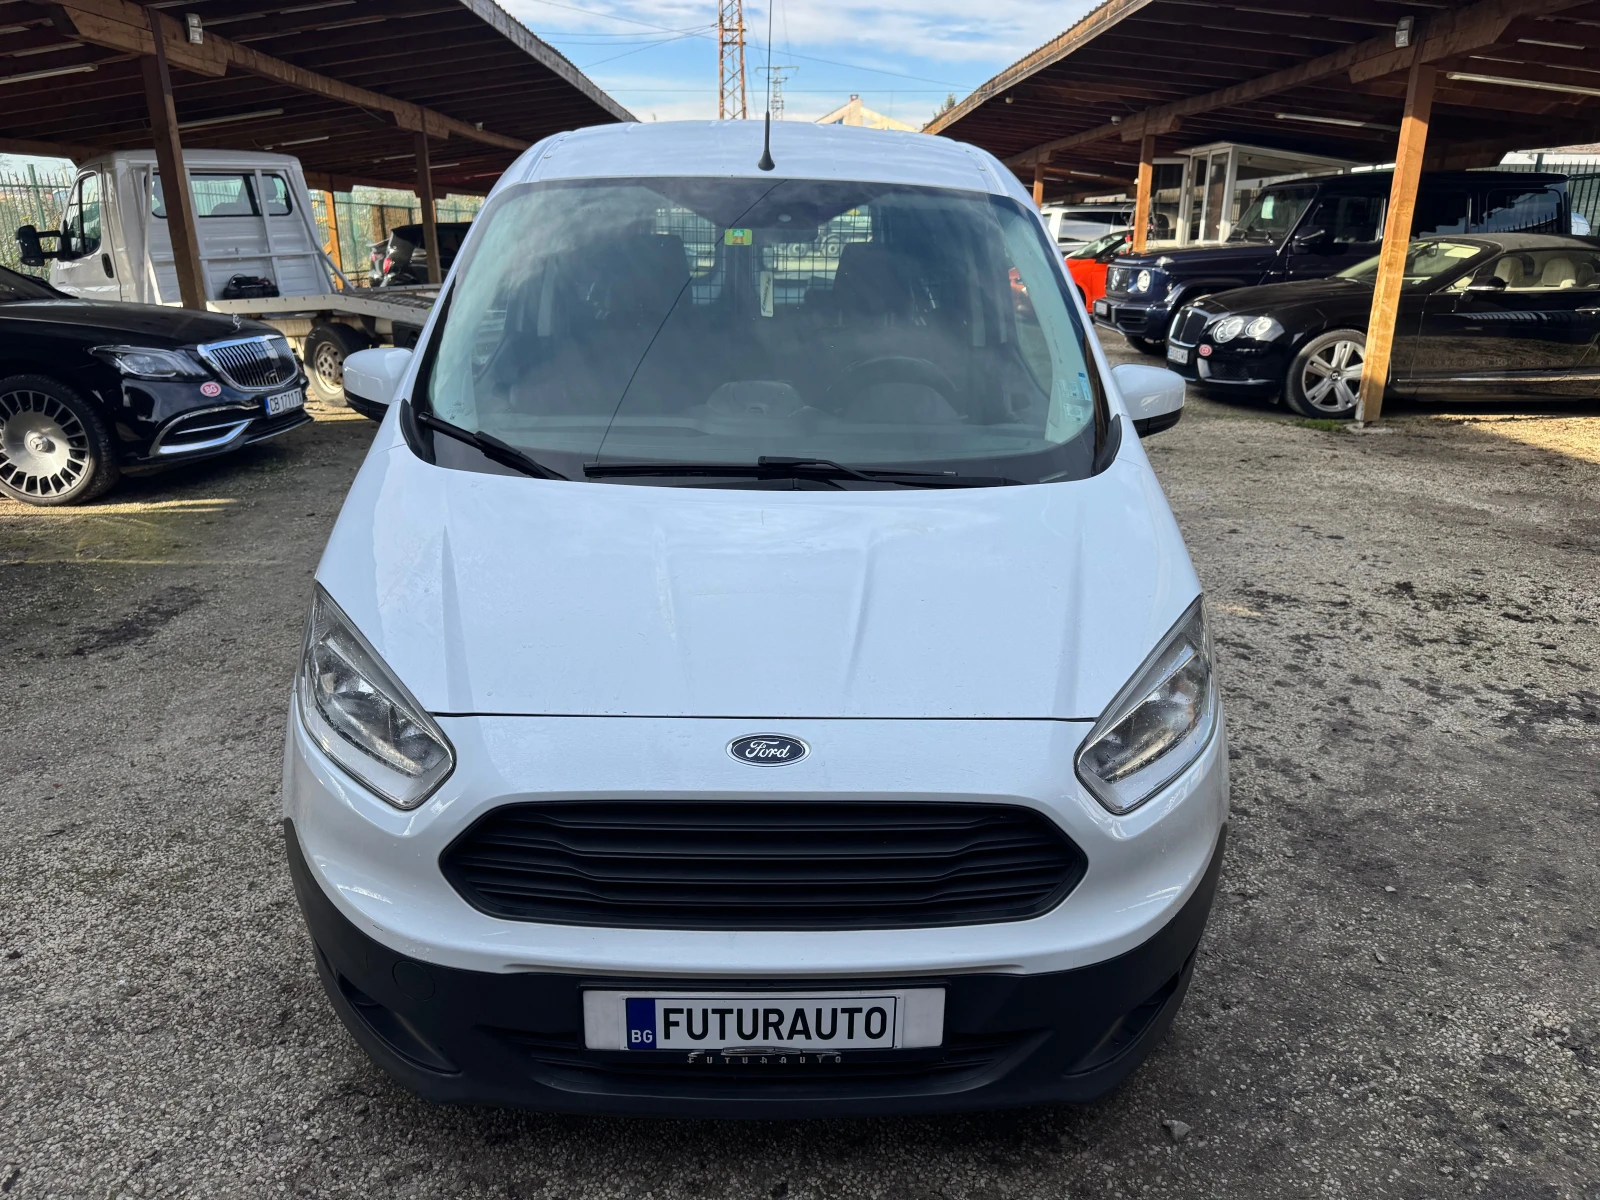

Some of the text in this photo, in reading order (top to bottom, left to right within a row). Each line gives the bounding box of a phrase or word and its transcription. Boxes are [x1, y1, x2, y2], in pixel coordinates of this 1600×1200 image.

[204, 384, 218, 394] BG
[269, 397, 280, 412] CB
[745, 740, 791, 758] Ford
[631, 1006, 888, 1043] BG FUTURAUTO
